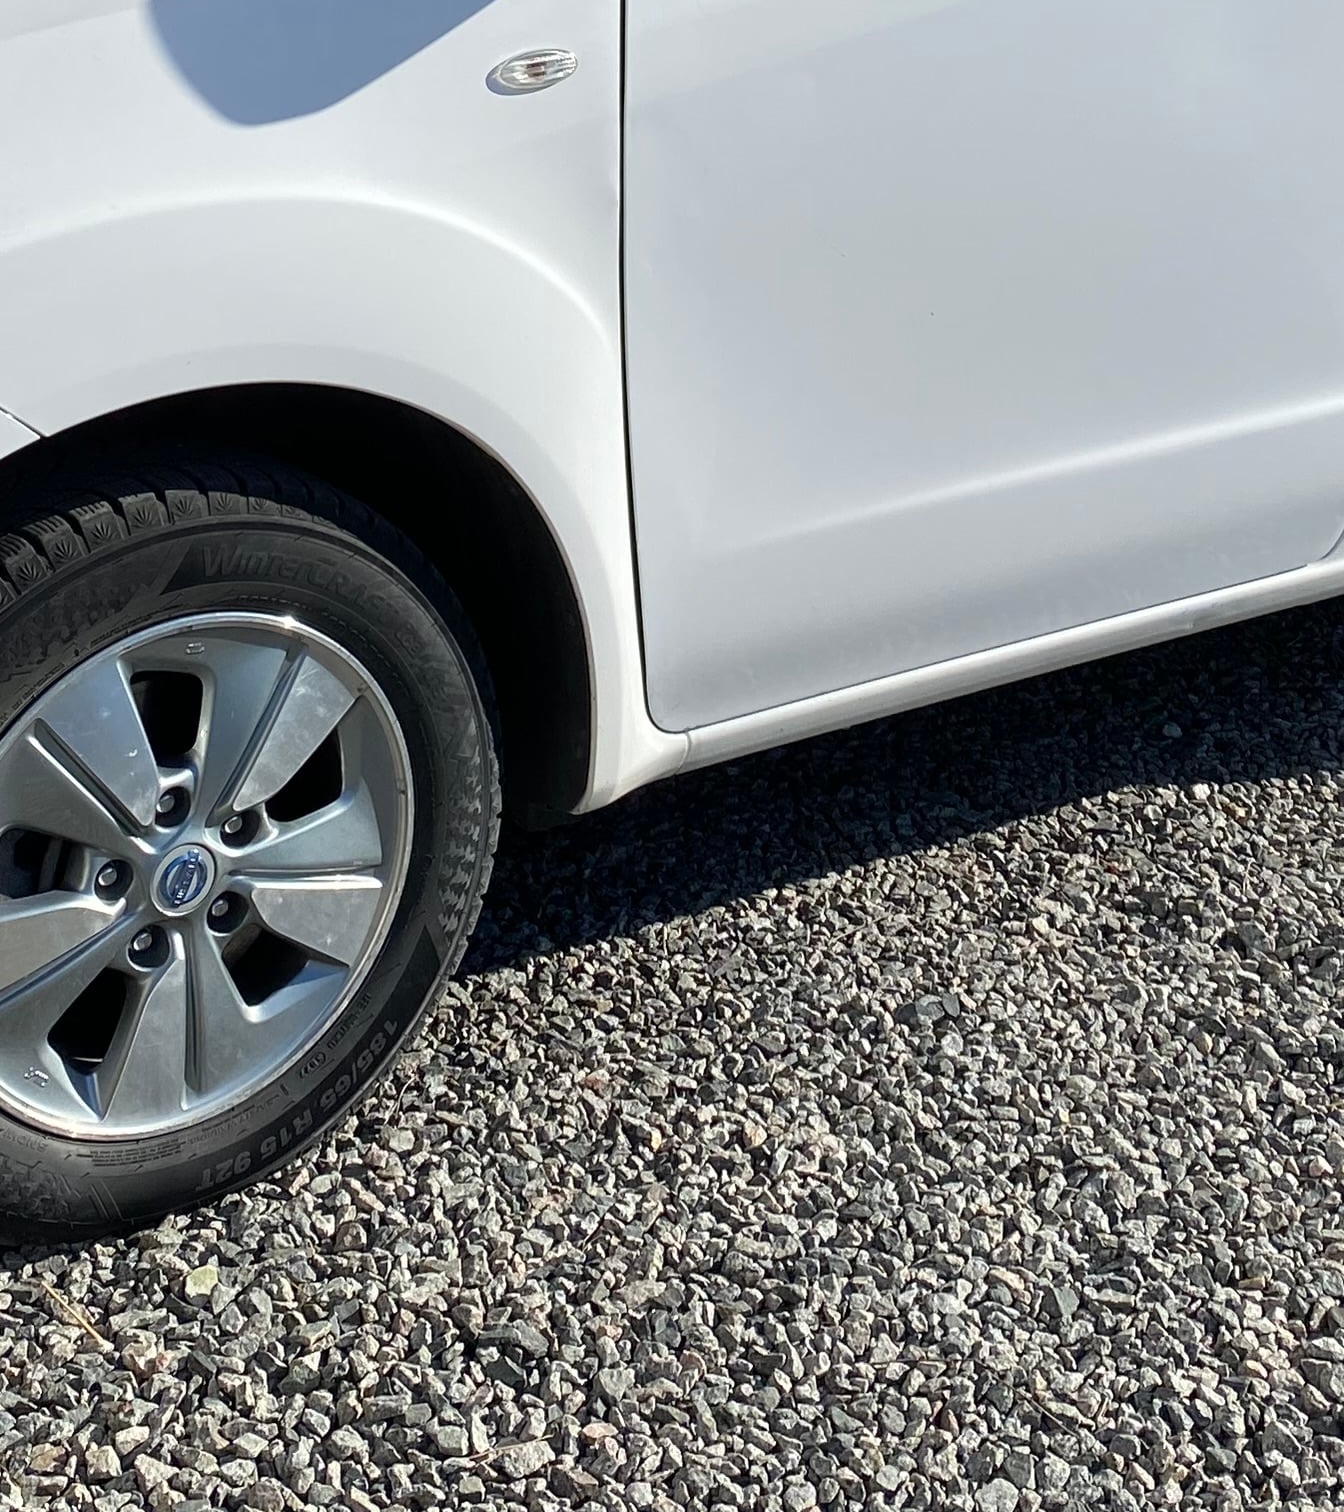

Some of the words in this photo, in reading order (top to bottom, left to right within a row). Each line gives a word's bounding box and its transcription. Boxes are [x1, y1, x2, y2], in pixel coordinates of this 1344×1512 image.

[320, 1019, 398, 1111] 185/65
[260, 1109, 313, 1161] R15
[196, 1151, 252, 1189] 92T
